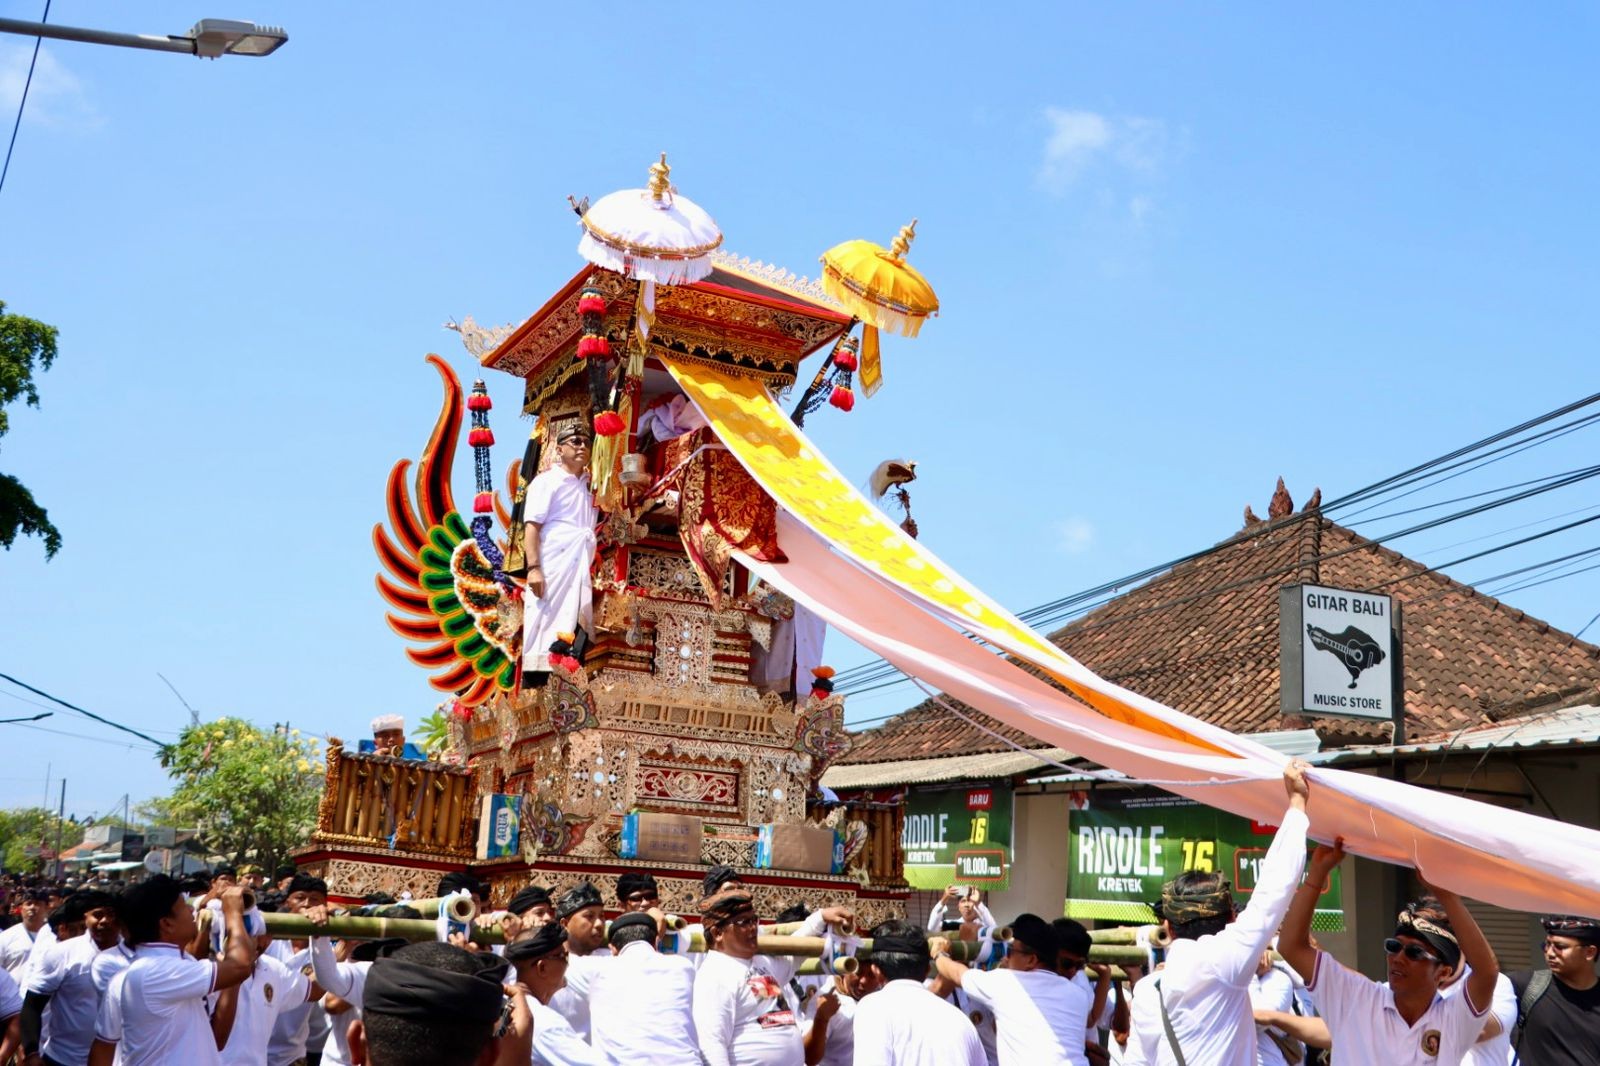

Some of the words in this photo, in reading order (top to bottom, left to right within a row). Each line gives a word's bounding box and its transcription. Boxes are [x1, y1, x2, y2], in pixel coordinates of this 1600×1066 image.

[1307, 594, 1347, 612] GITAR
[1353, 599, 1383, 616] BALI
[1314, 694, 1346, 706] MUSIC
[1350, 697, 1382, 709] STORE
[969, 794, 989, 805] BARU
[497, 812, 509, 841] AQUA
[970, 818, 986, 844] 16
[908, 852, 935, 862] KRETEK
[1079, 826, 1164, 876] RIDDLE
[1098, 877, 1143, 893] KRETEK
